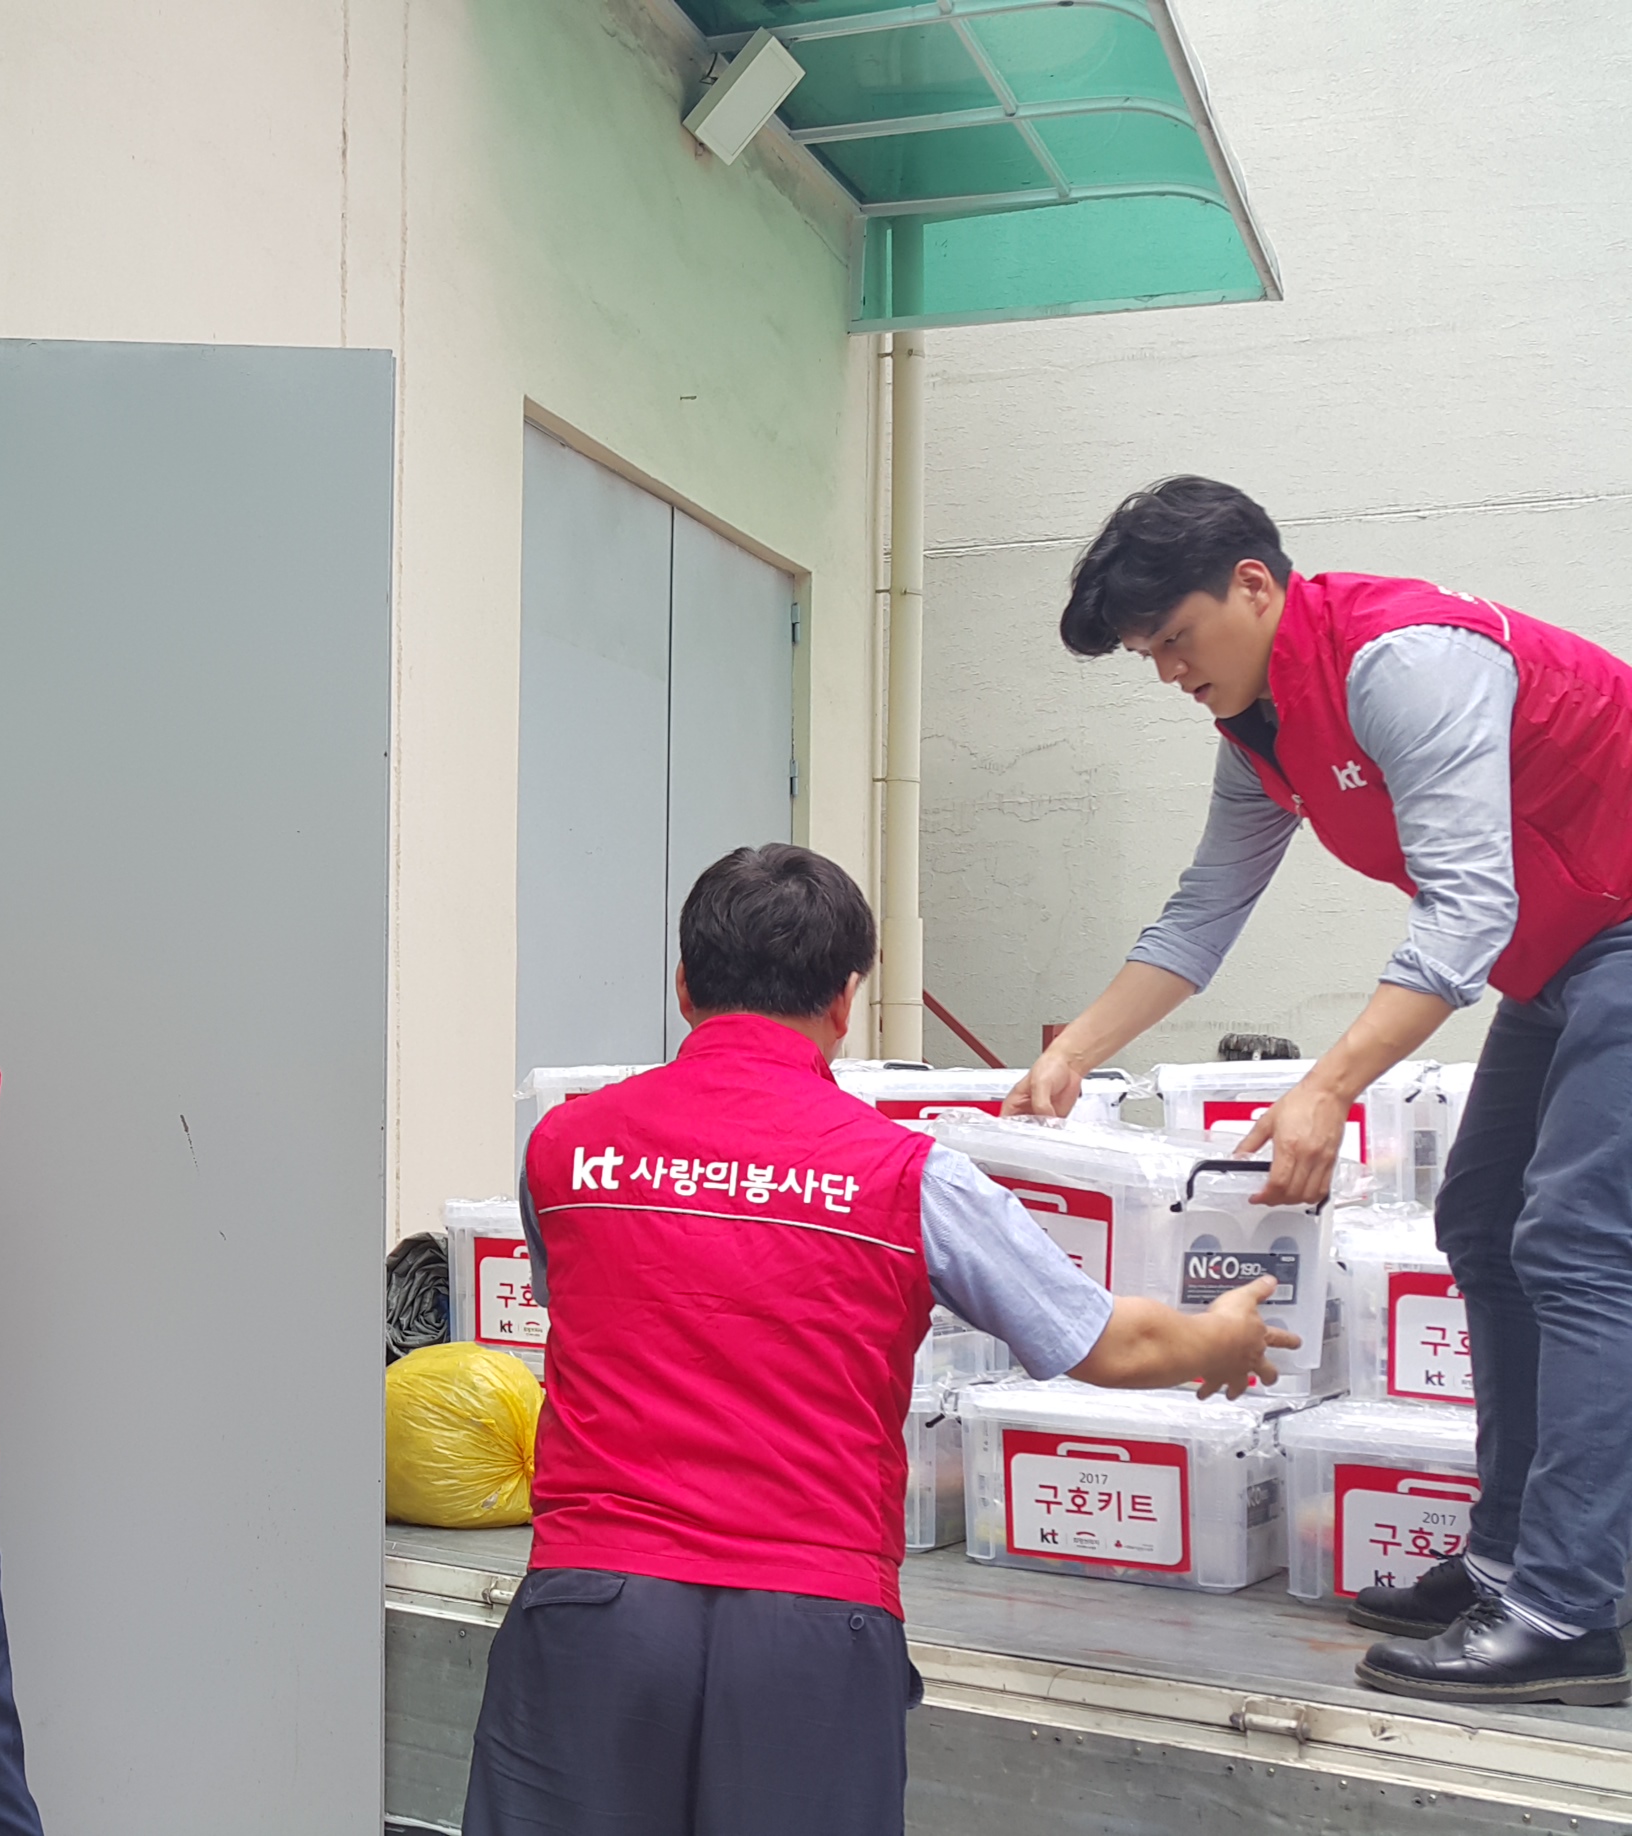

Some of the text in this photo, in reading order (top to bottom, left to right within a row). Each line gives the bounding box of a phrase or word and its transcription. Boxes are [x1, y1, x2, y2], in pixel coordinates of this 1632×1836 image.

[1331, 760, 1368, 791] kt
[571, 1146, 860, 1213] kt 사랑의봉사단
[500, 1320, 513, 1334] kt
[1425, 1370, 1444, 1386] kt
[1079, 1472, 1108, 1485] 2017
[1034, 1484, 1157, 1522] 구호키트
[1422, 1511, 1456, 1526] 2017
[1040, 1528, 1059, 1544] kt
[1375, 1570, 1395, 1588] kt
